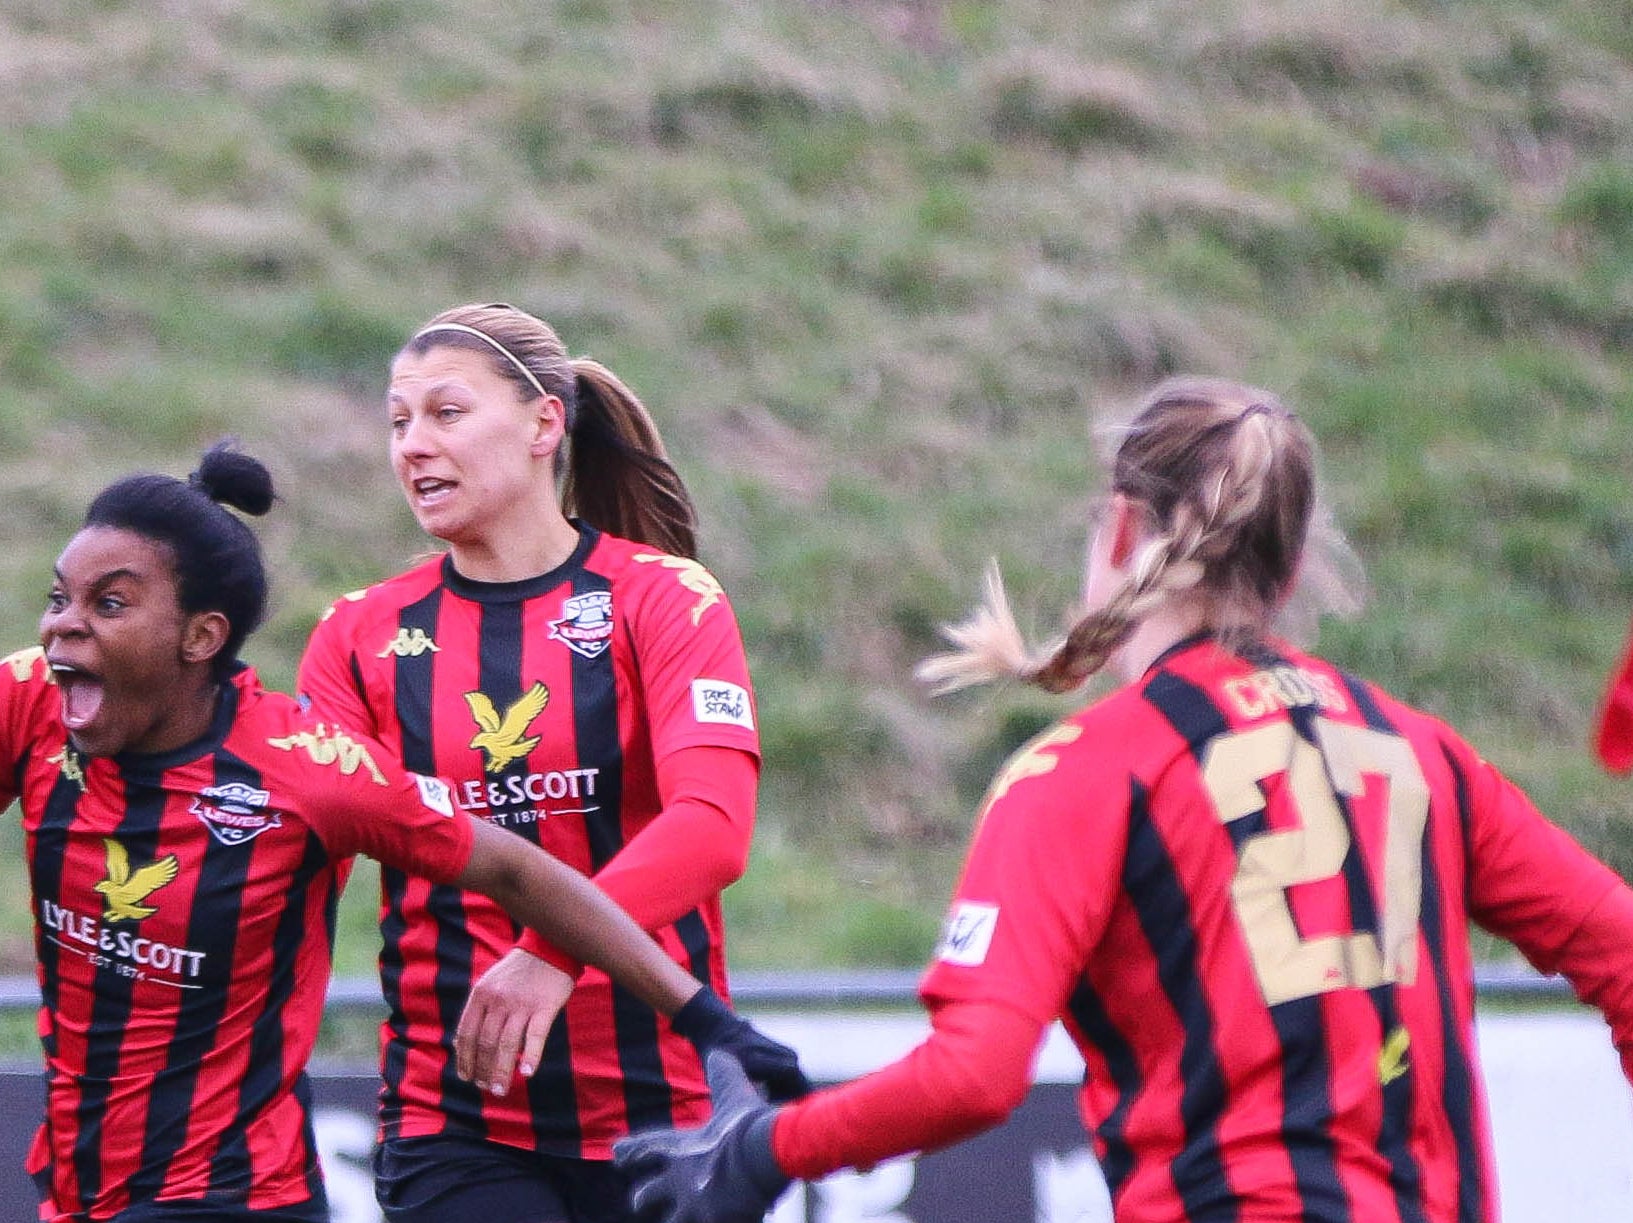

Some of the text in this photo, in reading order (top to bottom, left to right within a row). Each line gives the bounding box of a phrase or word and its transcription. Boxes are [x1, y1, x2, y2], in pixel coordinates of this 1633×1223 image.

[702, 688, 732, 702] TAKE
[704, 701, 745, 720] STAND
[513, 808, 547, 824] 1874
[1200, 716, 1431, 1007] 27
[86, 952, 112, 969] EST
